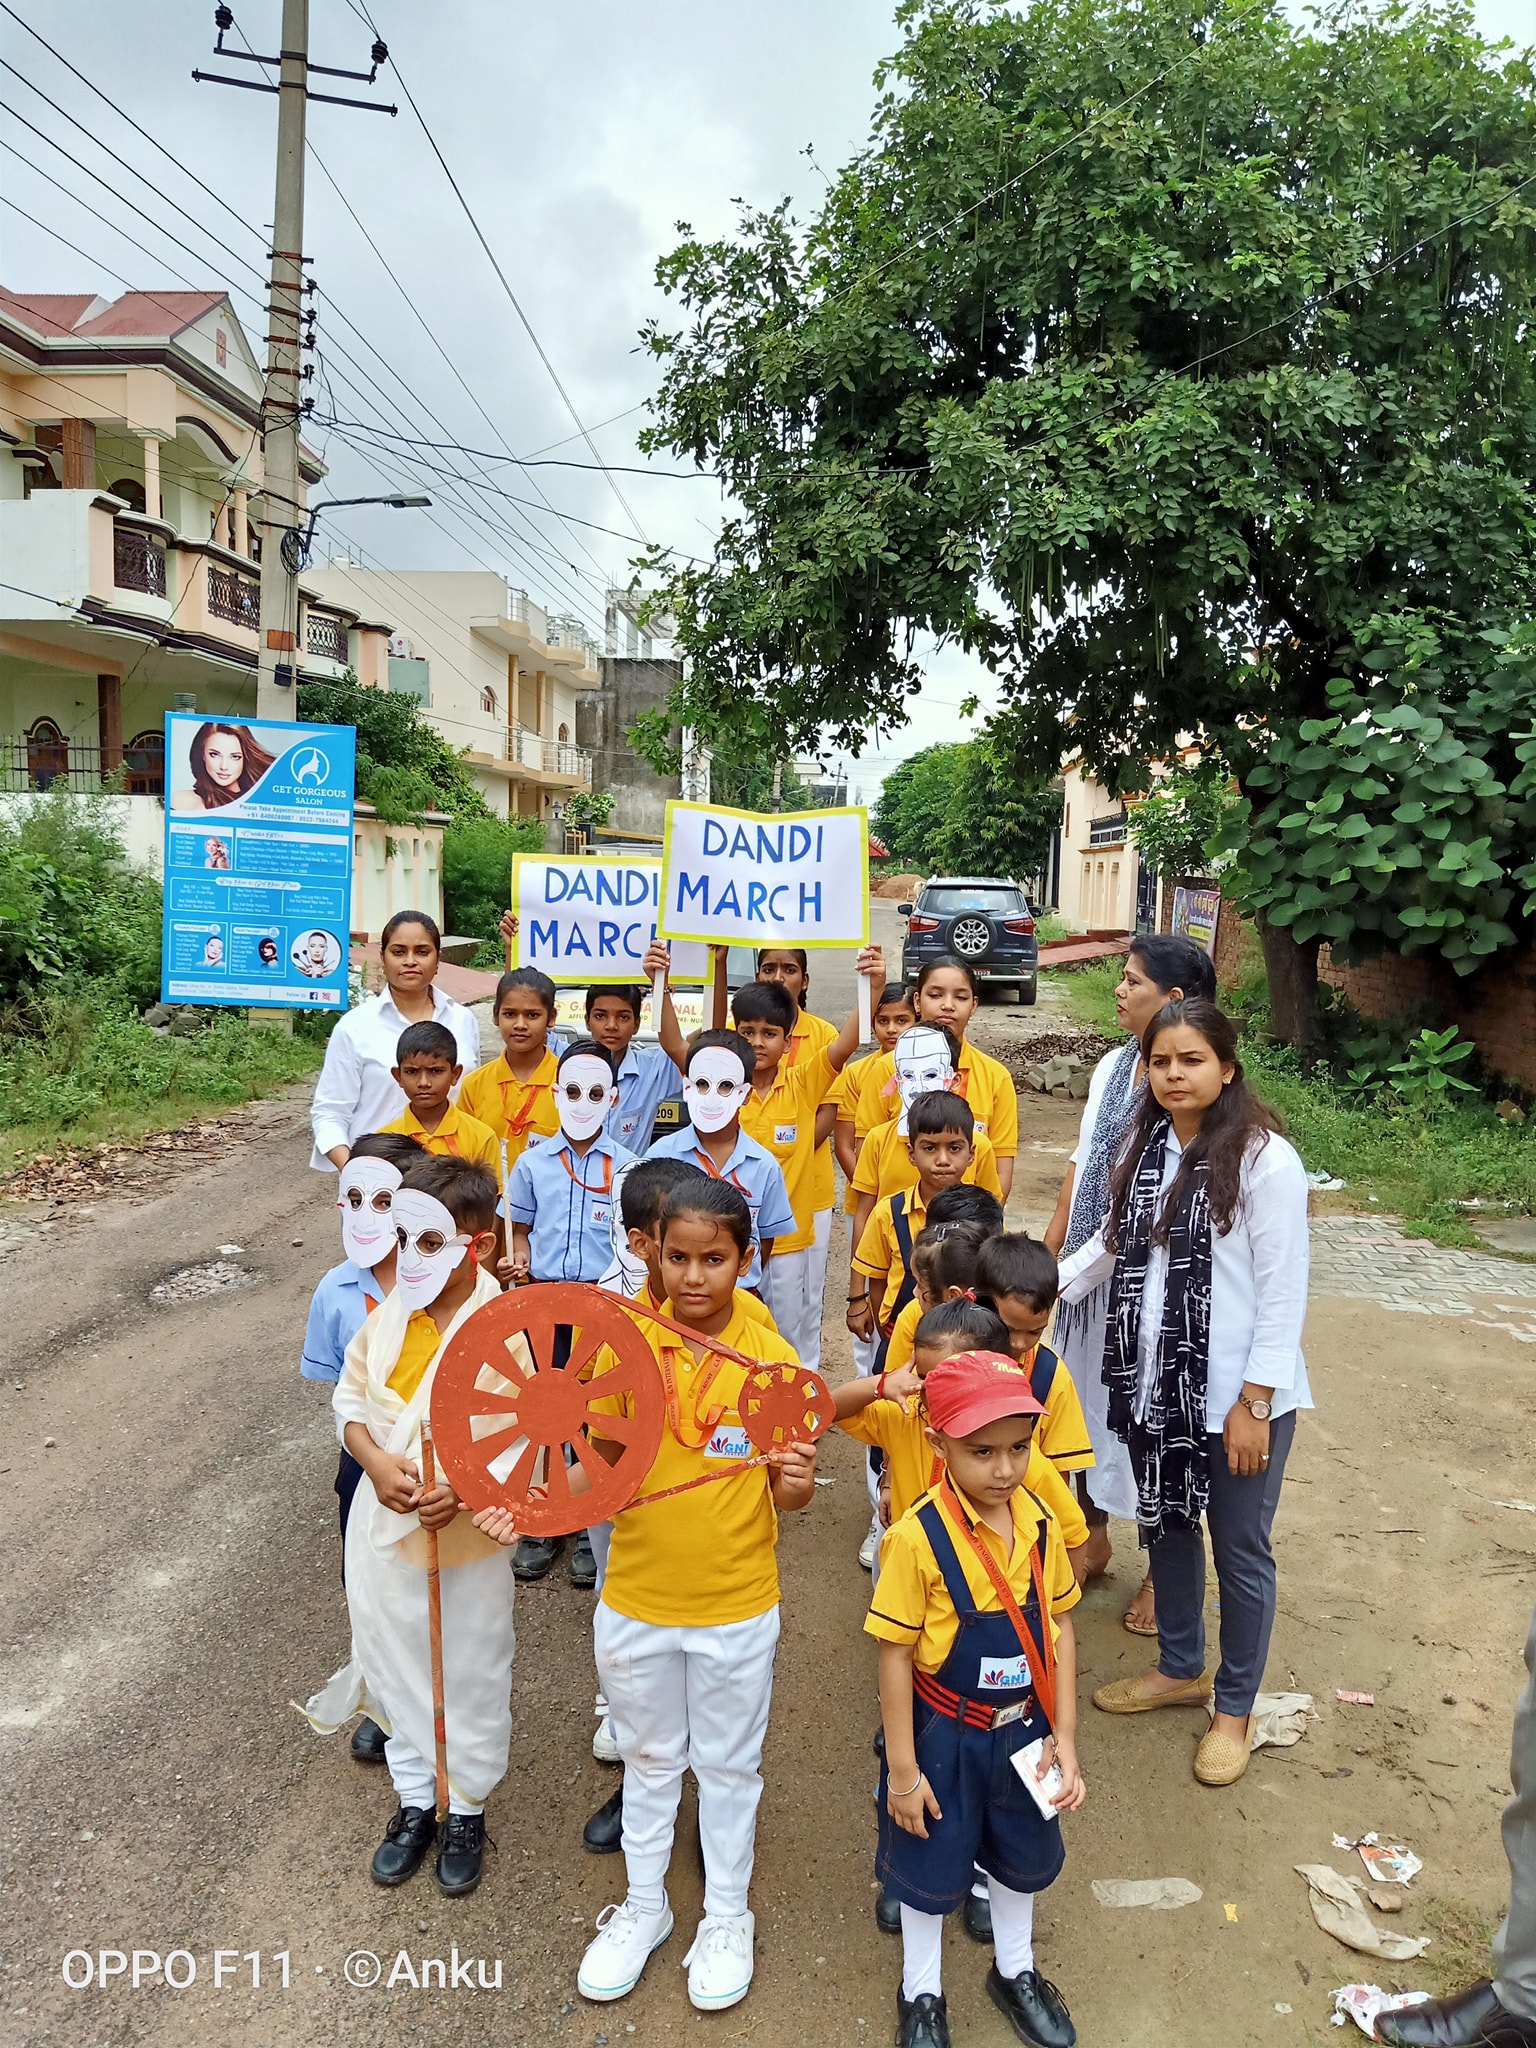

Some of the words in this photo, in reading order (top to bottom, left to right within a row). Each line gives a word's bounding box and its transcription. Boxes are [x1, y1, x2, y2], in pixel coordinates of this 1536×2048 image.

[272, 785, 292, 794] GET
[293, 786, 347, 798] GORGEOUS
[295, 797, 323, 806] SALON
[272, 806, 306, 815] Appointment
[325, 810, 346, 819] Coming
[703, 819, 823, 863] DANDI
[544, 867, 658, 906] DANDI
[676, 872, 822, 922] MARCH
[656, 1108, 673, 1119] 209
[724, 1443, 749, 1454] GNI
[1000, 1673, 1026, 1685] GNI
